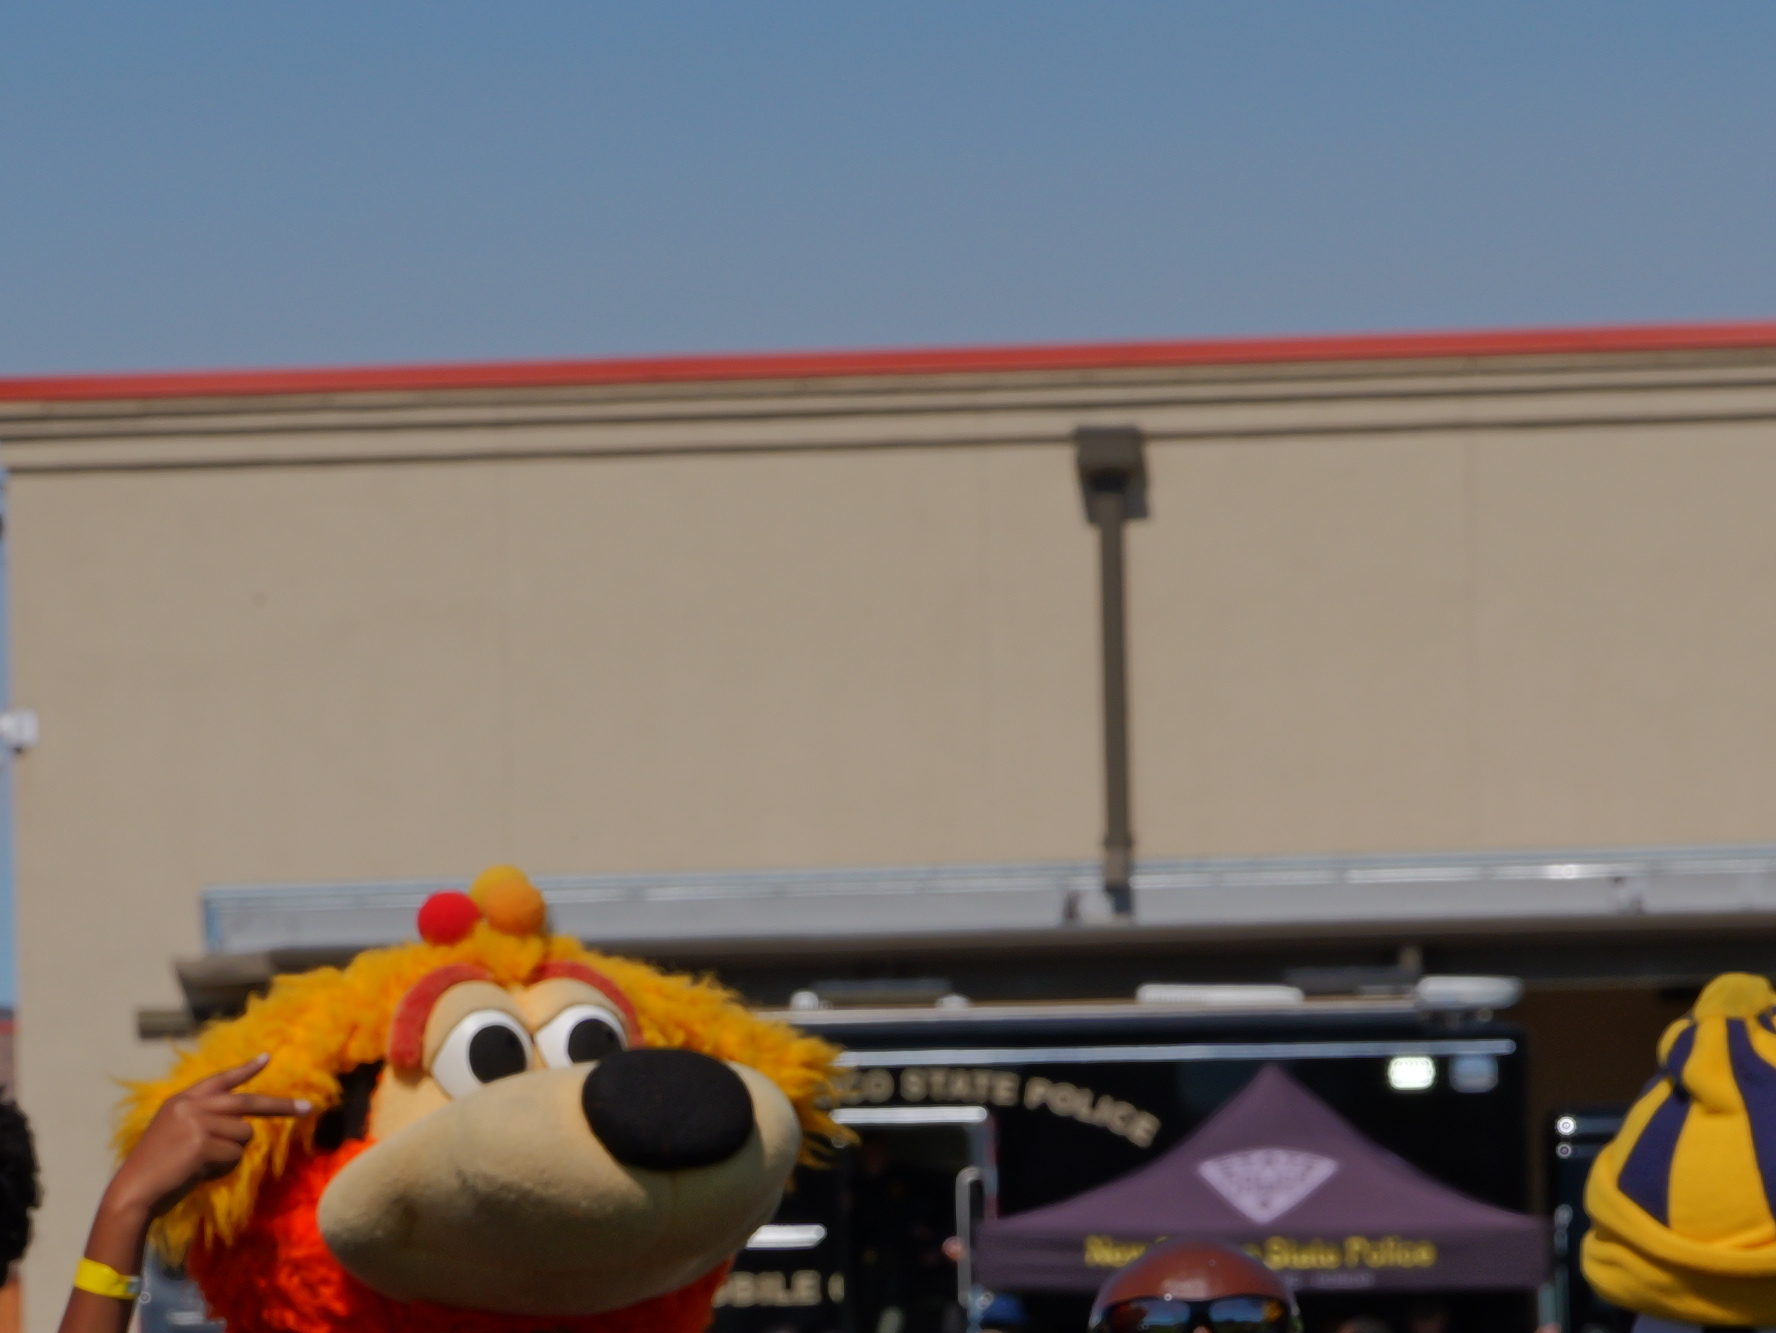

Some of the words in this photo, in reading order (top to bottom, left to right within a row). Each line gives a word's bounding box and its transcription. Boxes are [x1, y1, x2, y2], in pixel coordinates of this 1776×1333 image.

[900, 1067, 1020, 1106] STATE
[1023, 1077, 1161, 1149] POLICE
[1264, 1235, 1342, 1270] State
[1344, 1235, 1436, 1268] Police
